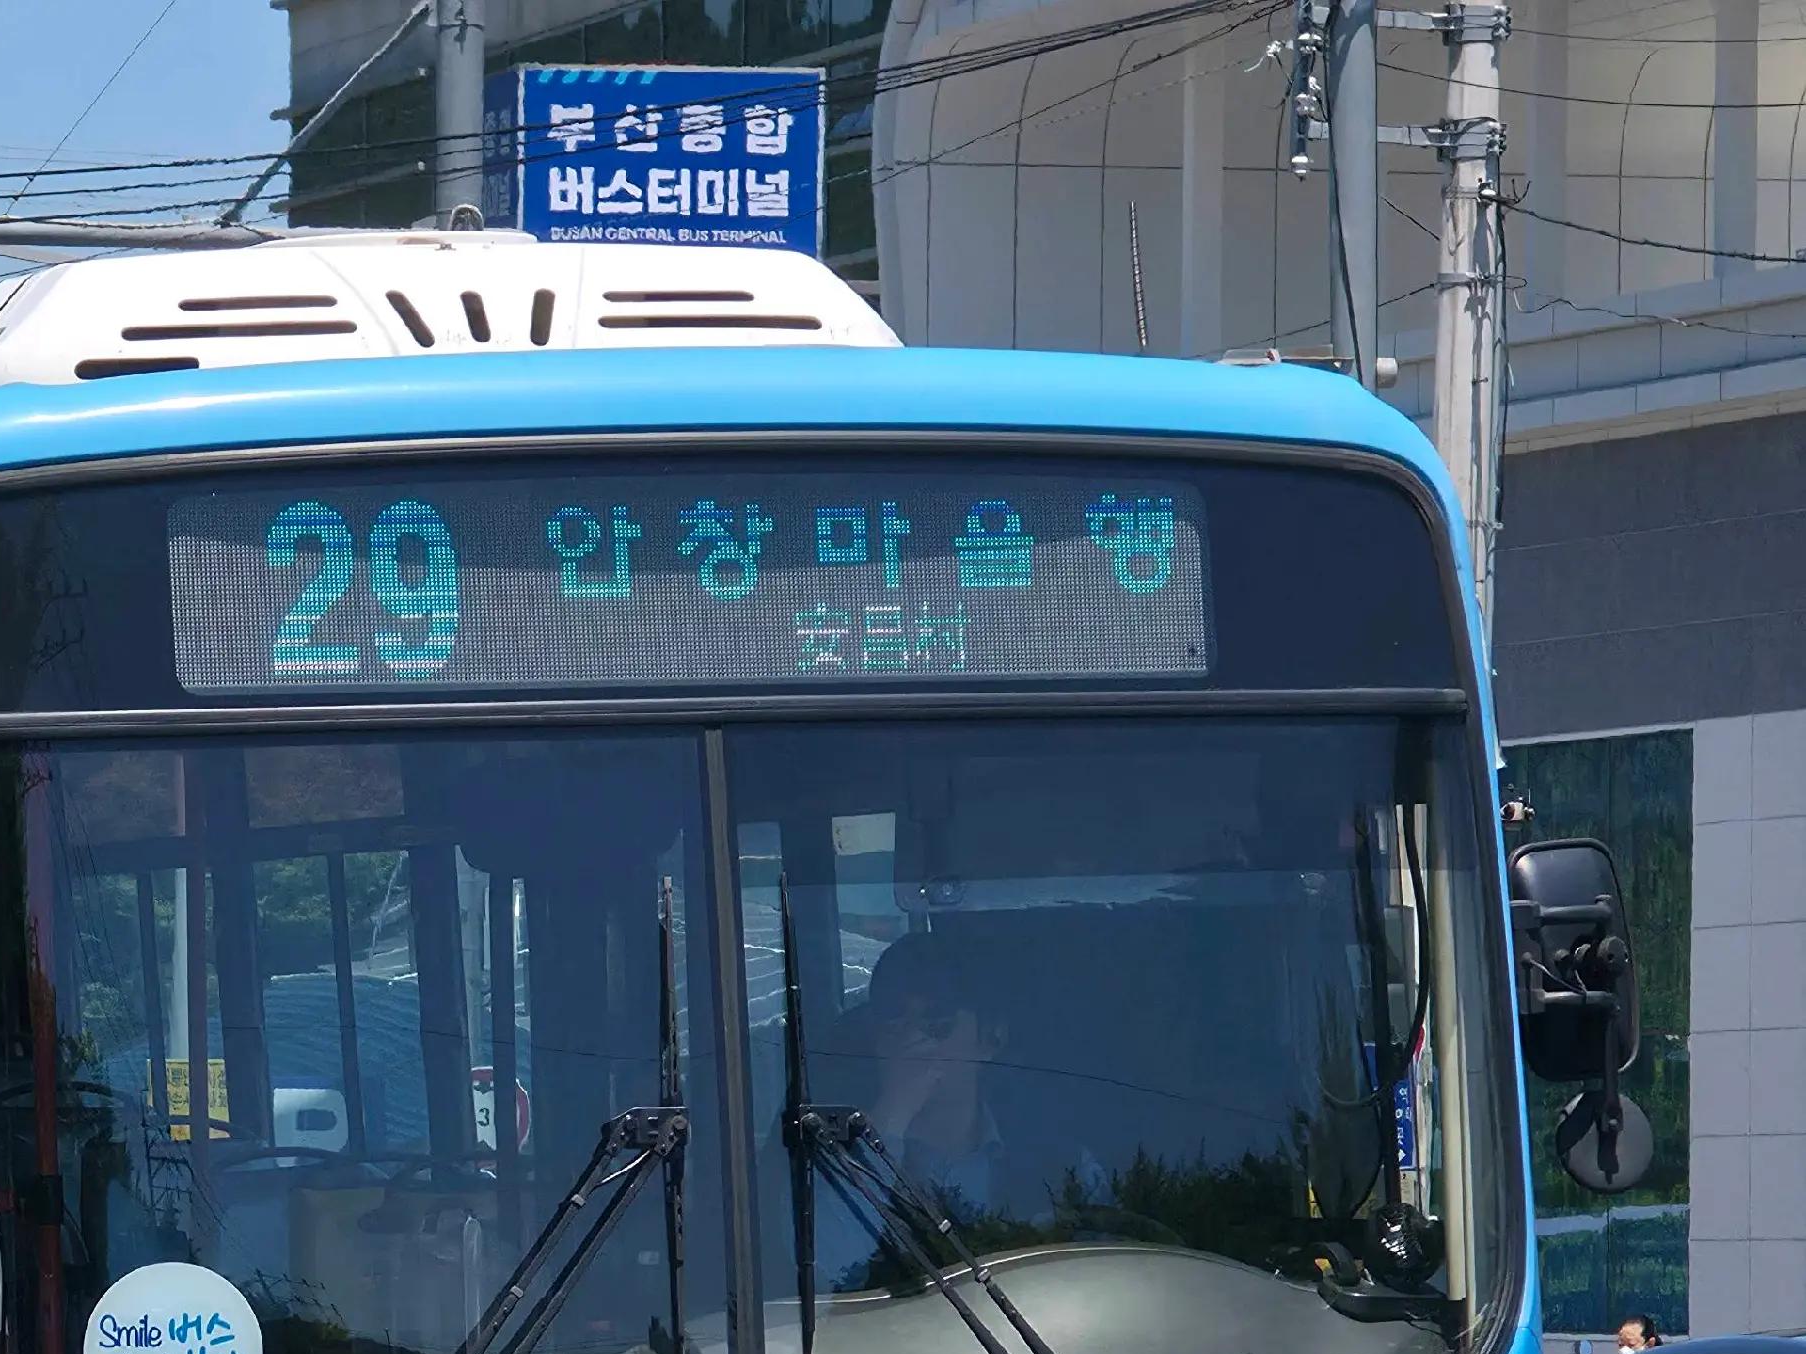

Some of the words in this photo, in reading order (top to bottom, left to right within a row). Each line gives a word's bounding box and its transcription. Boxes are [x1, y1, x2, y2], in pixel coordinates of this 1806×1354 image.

[548, 166, 790, 217] 버스터미널
[605, 226, 675, 242] CENTRAL
[678, 228, 708, 243] BUS
[711, 229, 787, 244] TERMINAL
[265, 500, 460, 678] 29
[99, 1314, 163, 1348] Smile
[168, 1312, 235, 1345] 버스
